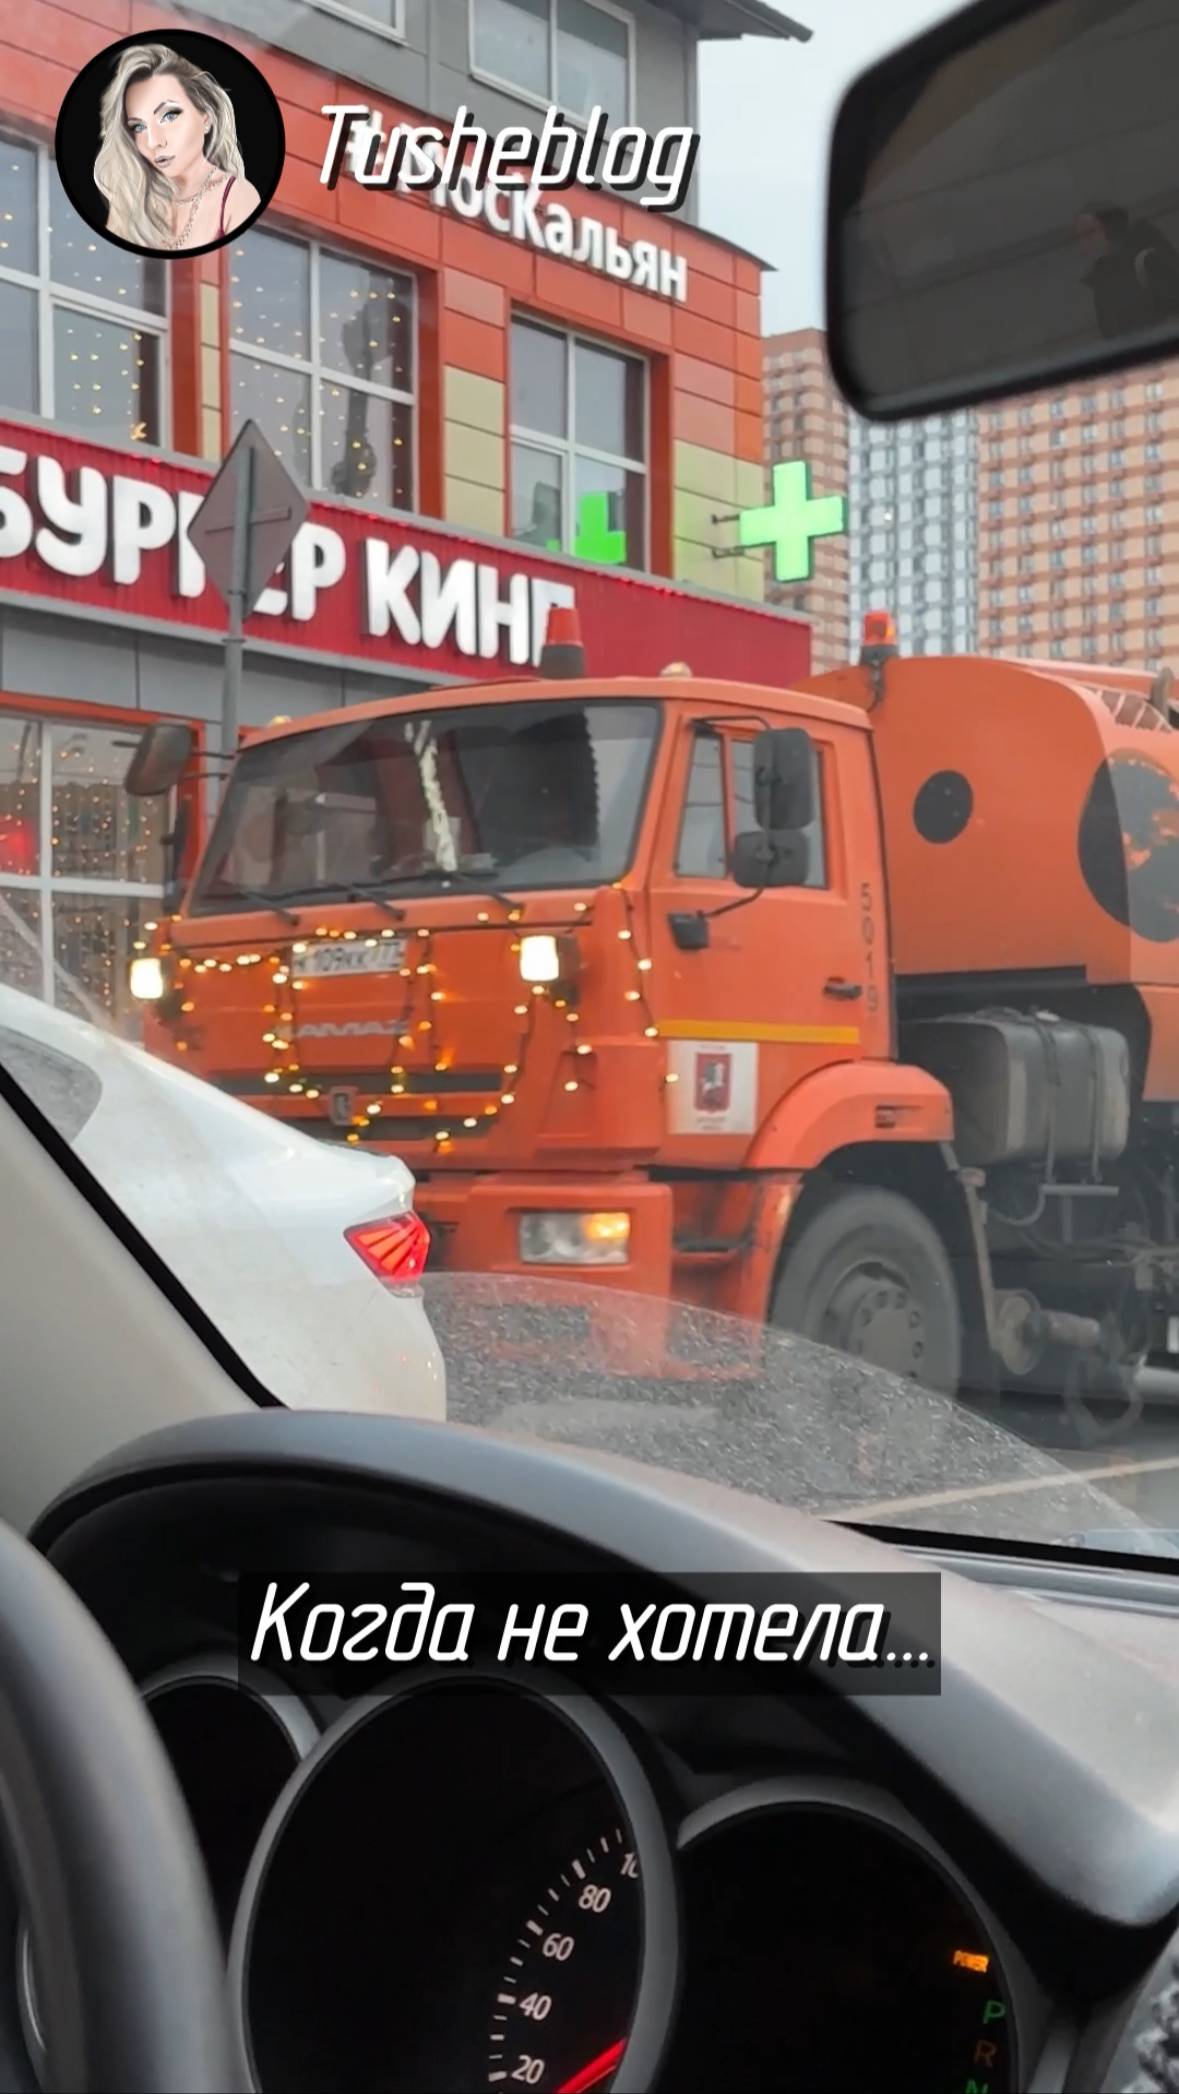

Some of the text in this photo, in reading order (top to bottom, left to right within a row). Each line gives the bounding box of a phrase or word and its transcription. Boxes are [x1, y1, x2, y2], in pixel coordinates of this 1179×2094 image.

[367, 538, 575, 668] КИНГ
[578, 1884, 611, 1913] 80
[542, 1932, 575, 1961] 60
[519, 1992, 552, 2021] 40
[983, 2000, 1006, 2024] P
[974, 2039, 997, 2067] R
[511, 2054, 545, 2084] 20
